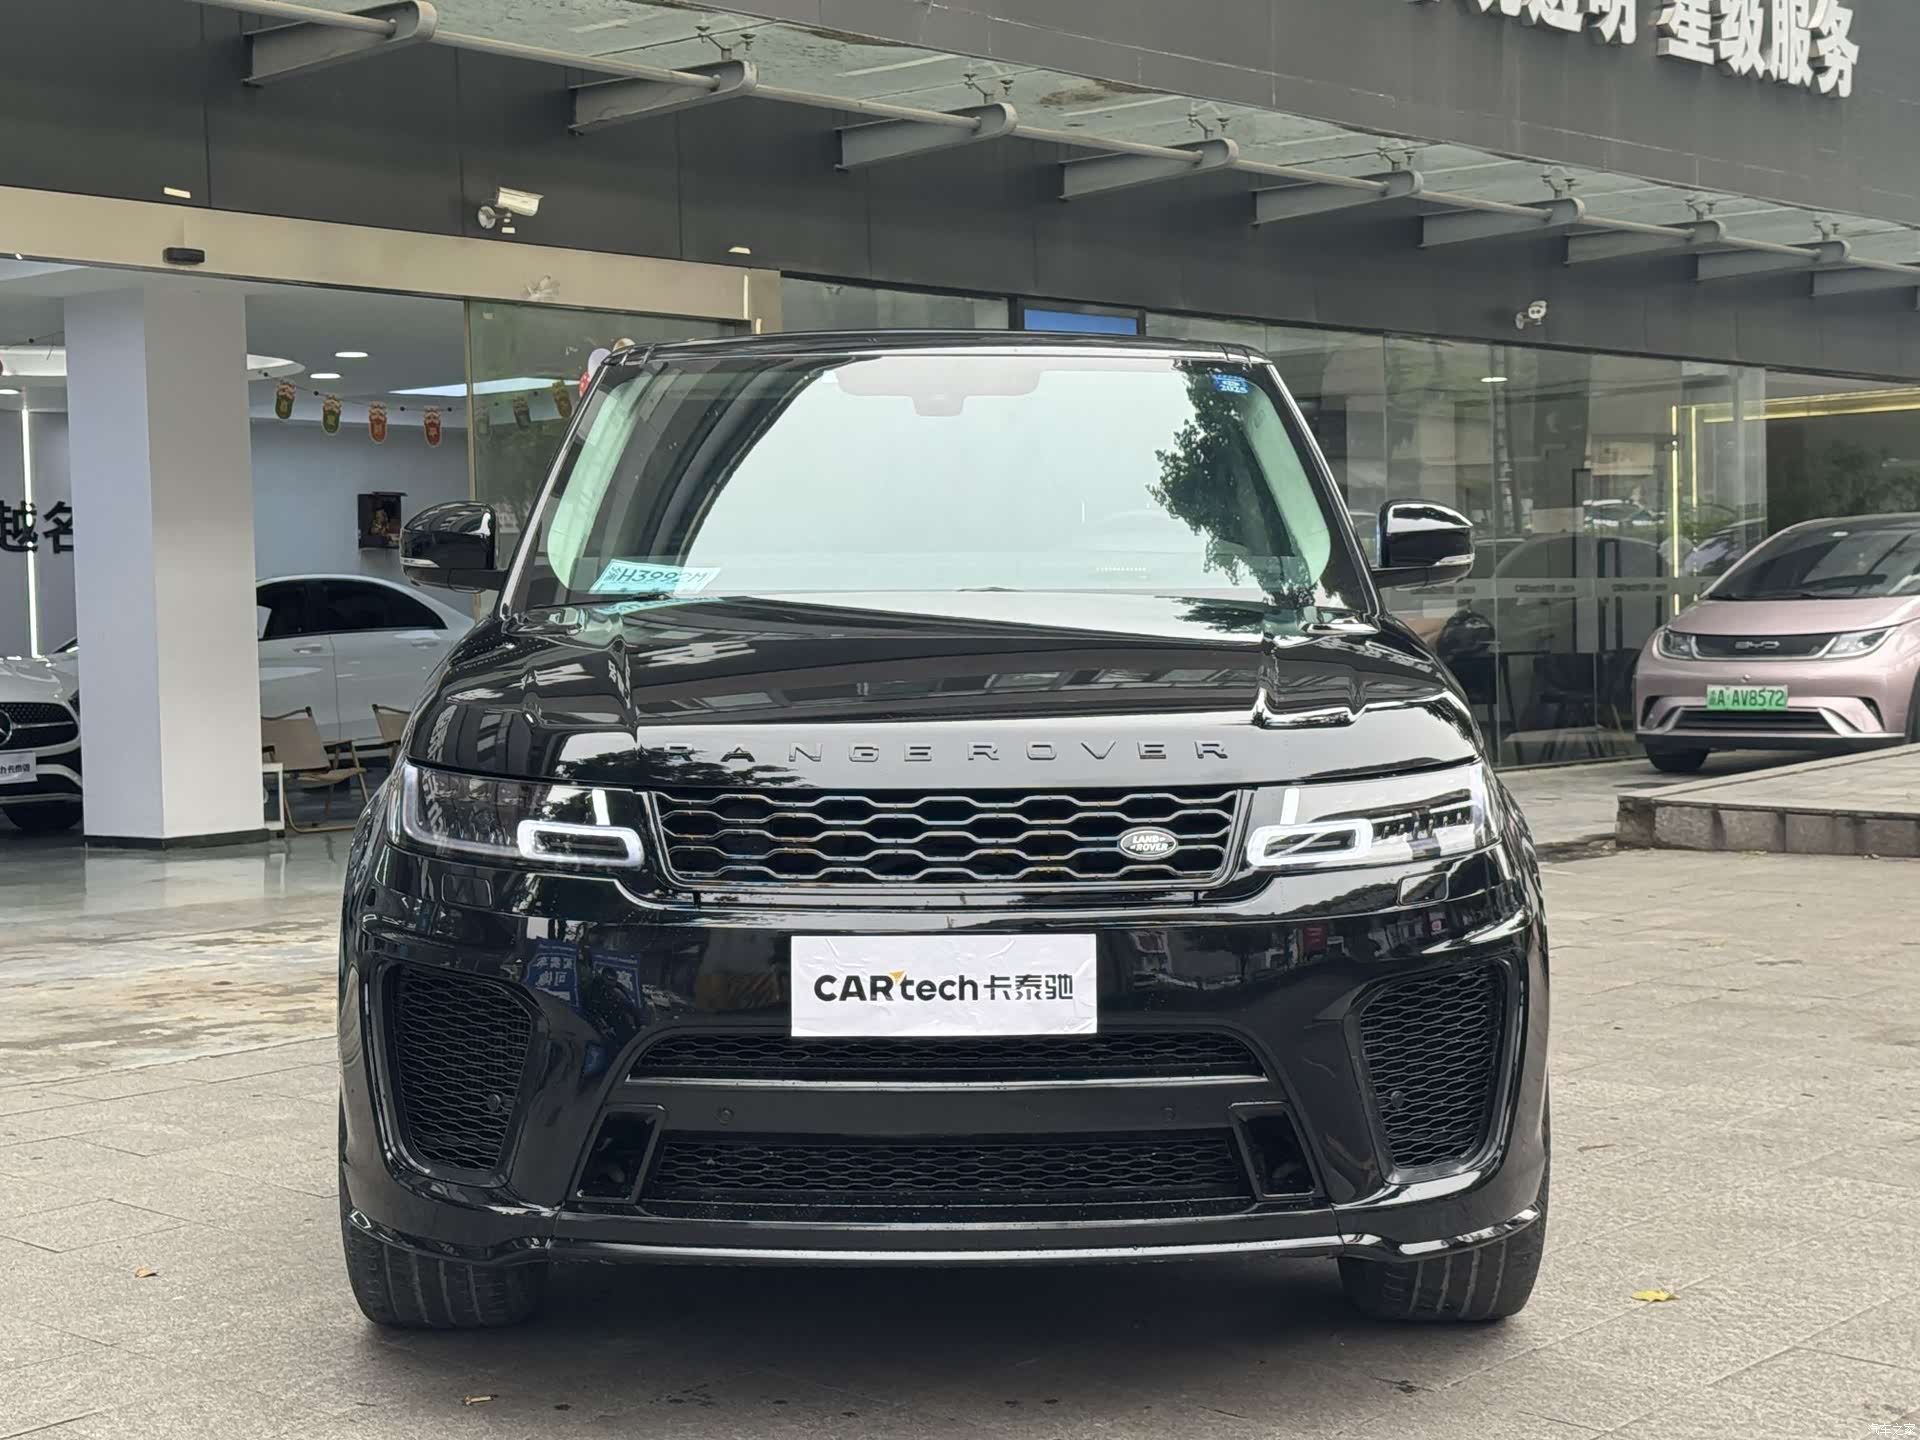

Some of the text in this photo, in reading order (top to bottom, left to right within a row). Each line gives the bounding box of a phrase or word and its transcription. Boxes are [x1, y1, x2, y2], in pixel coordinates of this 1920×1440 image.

[663, 740, 1228, 762] RANGE ROVER
[1132, 835, 1160, 843] LAND
[1136, 843, 1169, 851] ROVER
[984, 974, 1073, 1000] 卡泰驰
